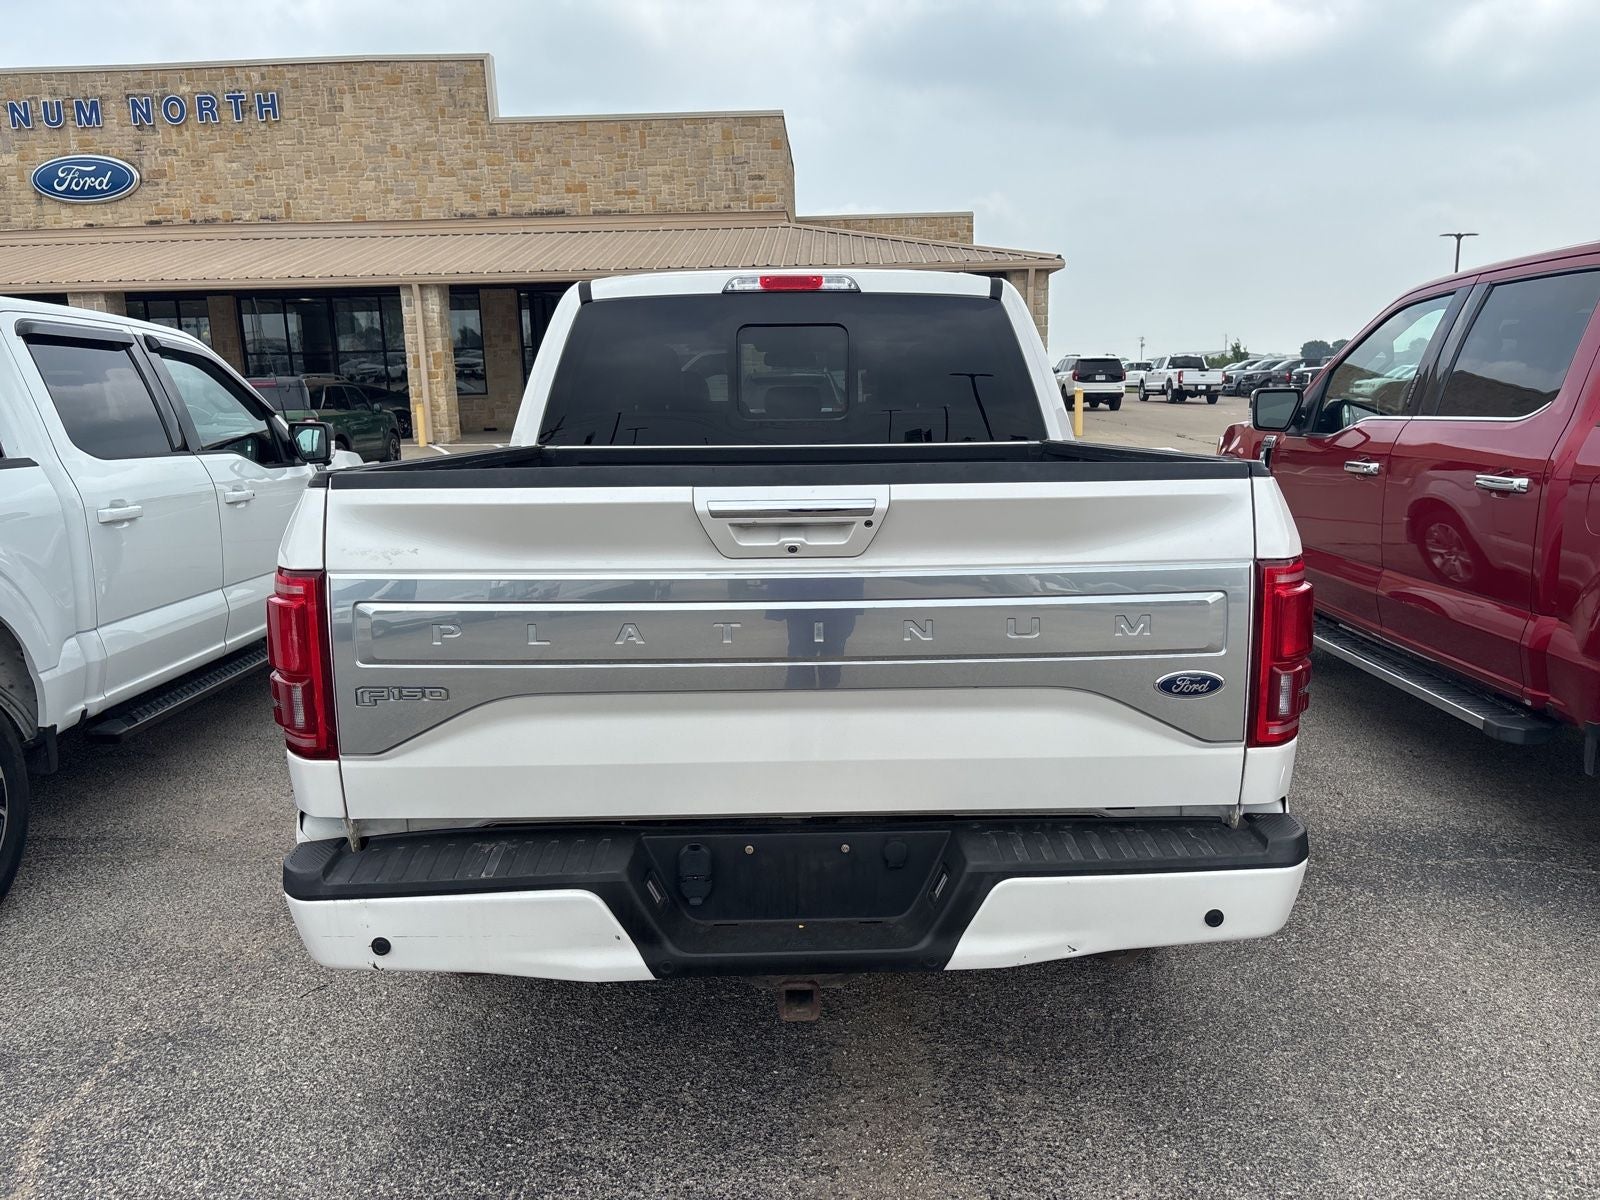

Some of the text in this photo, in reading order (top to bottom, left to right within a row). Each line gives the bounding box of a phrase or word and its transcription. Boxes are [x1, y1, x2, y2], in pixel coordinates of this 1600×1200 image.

[7, 91, 280, 130] NUM NORTH
[53, 165, 112, 192] Ford
[431, 614, 1152, 646] PLATINUM
[1171, 676, 1211, 693] Ford
